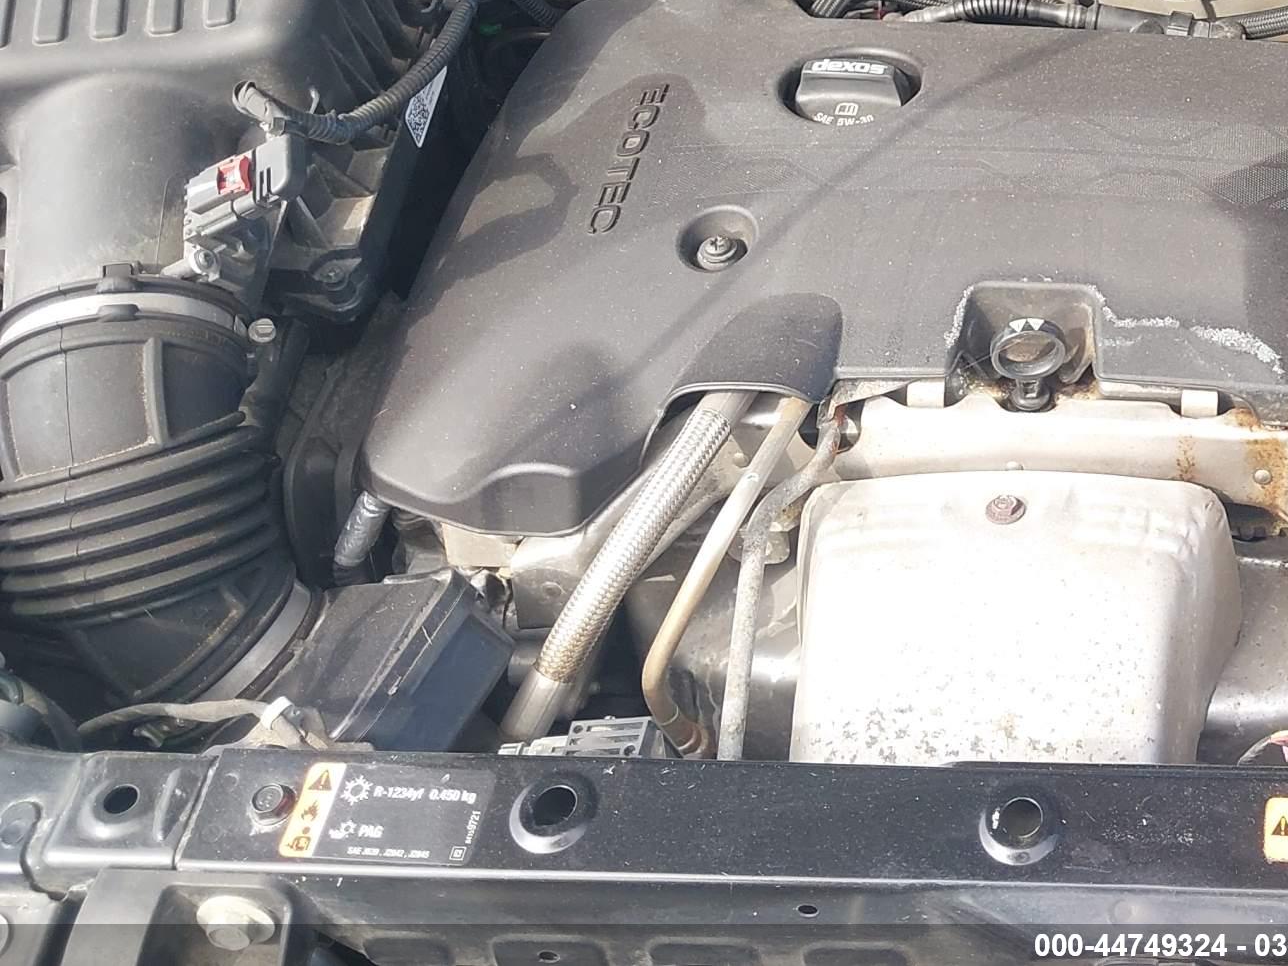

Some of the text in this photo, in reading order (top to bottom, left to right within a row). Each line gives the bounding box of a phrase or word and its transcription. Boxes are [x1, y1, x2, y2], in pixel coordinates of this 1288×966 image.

[811, 58, 888, 75] dexos
[813, 112, 874, 127] SAE 5W-30
[587, 83, 670, 235] ECOTEC
[373, 785, 425, 803] R-1234yf
[460, 789, 478, 805] kg
[357, 824, 385, 839] PAG
